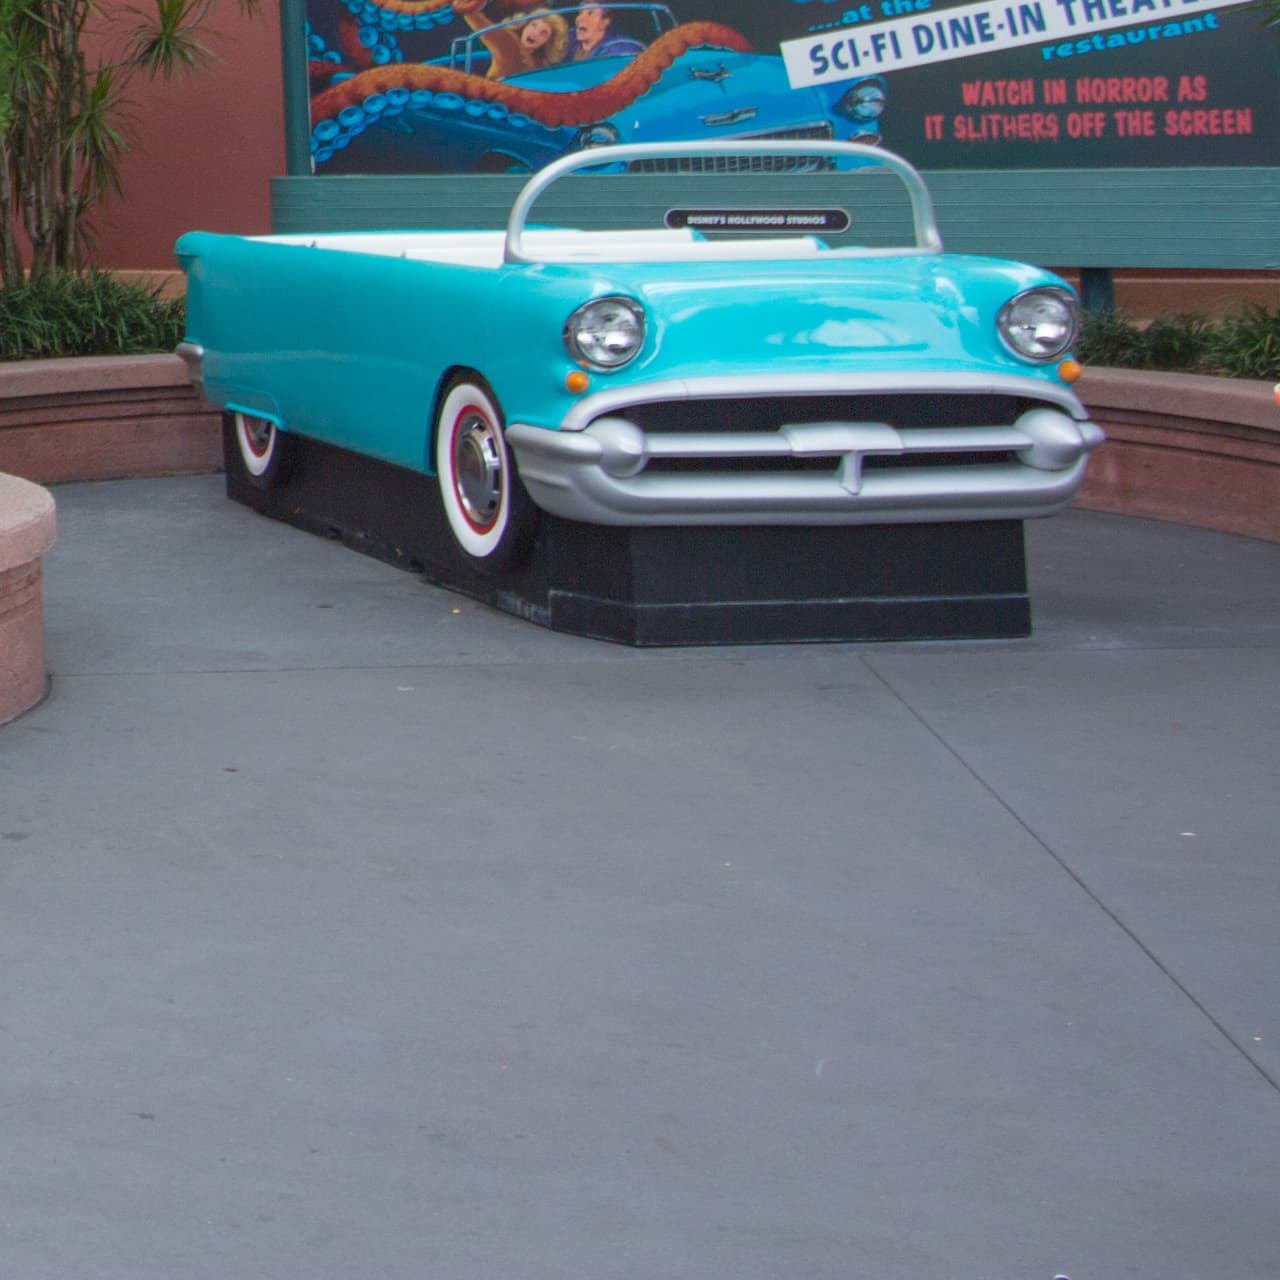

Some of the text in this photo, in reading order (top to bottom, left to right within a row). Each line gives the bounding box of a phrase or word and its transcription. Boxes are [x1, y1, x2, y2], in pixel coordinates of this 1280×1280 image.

[809, 30, 903, 76] SCI-FI
[911, 2, 1048, 56] DINE-IN
[1042, 12, 1220, 61] restaurant
[962, 74, 1207, 107] WATCH IN HORROR AS
[925, 107, 1253, 143] IT SLITHERS OFF THE SCREEN
